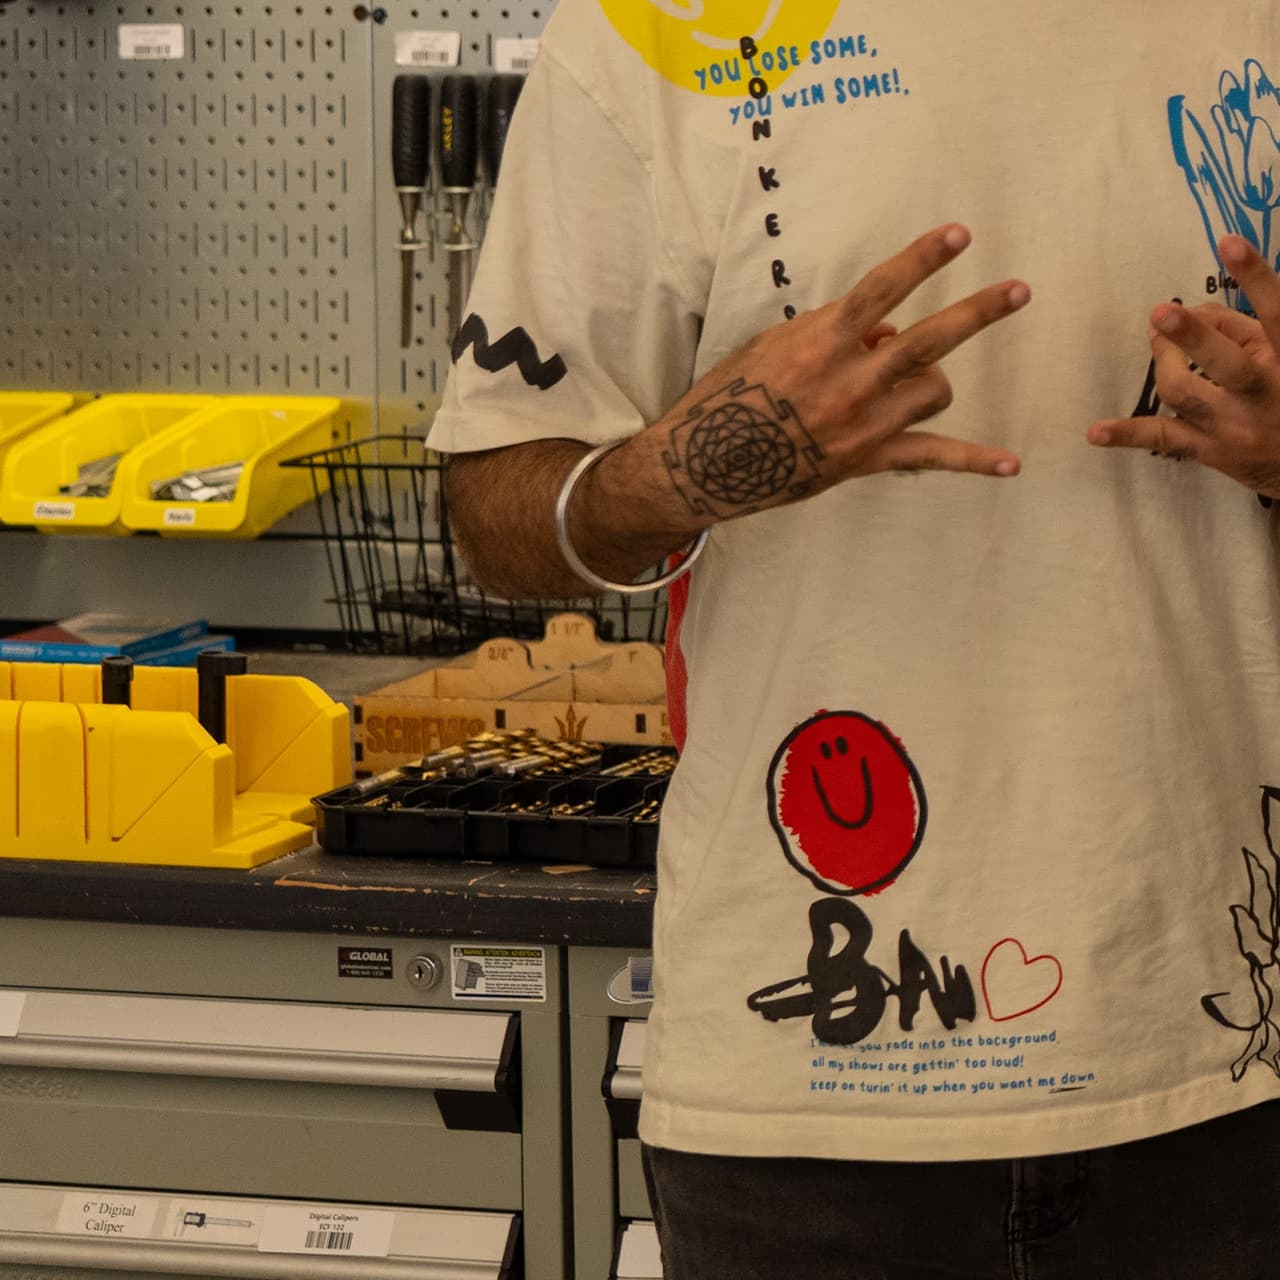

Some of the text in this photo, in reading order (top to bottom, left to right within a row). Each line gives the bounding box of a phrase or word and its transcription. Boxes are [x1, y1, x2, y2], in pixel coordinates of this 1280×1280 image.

[694, 34, 878, 90] YOU LOSE SOME,
[729, 94, 772, 125] YOU
[781, 83, 825, 109] WIN
[349, 951, 390, 962] GLOBAL
[859, 1043, 882, 1053] you
[886, 1039, 914, 1052] fade
[919, 1038, 946, 1050] into
[951, 1036, 974, 1048] the
[812, 1056, 825, 1069] all
[828, 1060, 845, 1073] my
[848, 1058, 884, 1071] shows
[888, 1061, 908, 1073] are
[965, 1058, 987, 1069] too
[991, 1055, 1024, 1069] loud!
[810, 1079, 838, 1093] keep
[841, 1081, 855, 1092] on
[898, 1081, 908, 1093] it
[913, 1083, 928, 1096] up
[932, 1080, 967, 1093] when
[971, 1080, 995, 1094] you
[1000, 1076, 1033, 1090] want
[1037, 1076, 1056, 1087] me
[98, 1202, 136, 1218] Digital
[309, 1213, 359, 1223] Digital Calipers
[85, 1219, 125, 1234] Caliper
[333, 1223, 345, 1231] 122
